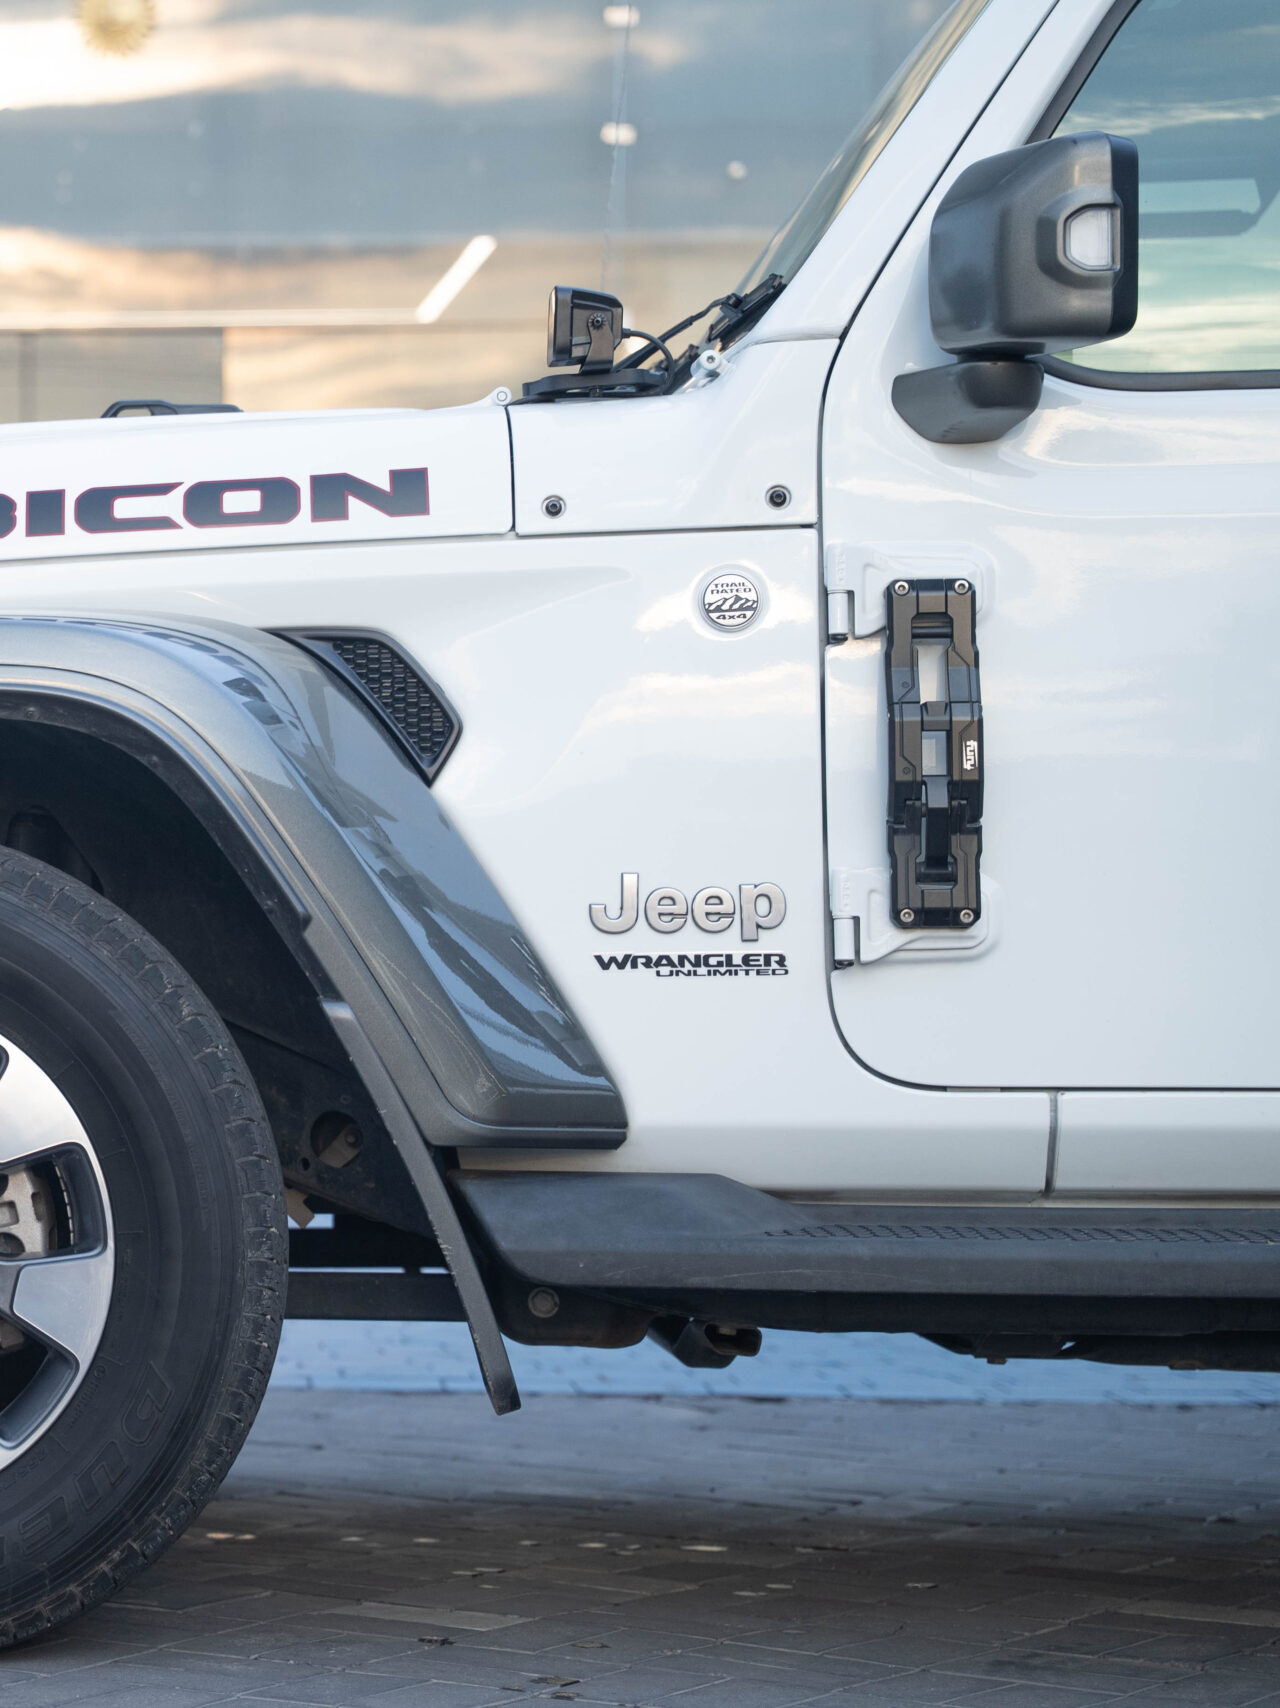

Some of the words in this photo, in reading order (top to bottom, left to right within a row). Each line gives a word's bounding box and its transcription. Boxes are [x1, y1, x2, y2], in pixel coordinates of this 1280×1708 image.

[710, 587, 752, 595] RATED
[588, 872, 787, 942] Jeep
[593, 953, 788, 971] WRANGLER
[655, 968, 789, 977] UNLIMITED
